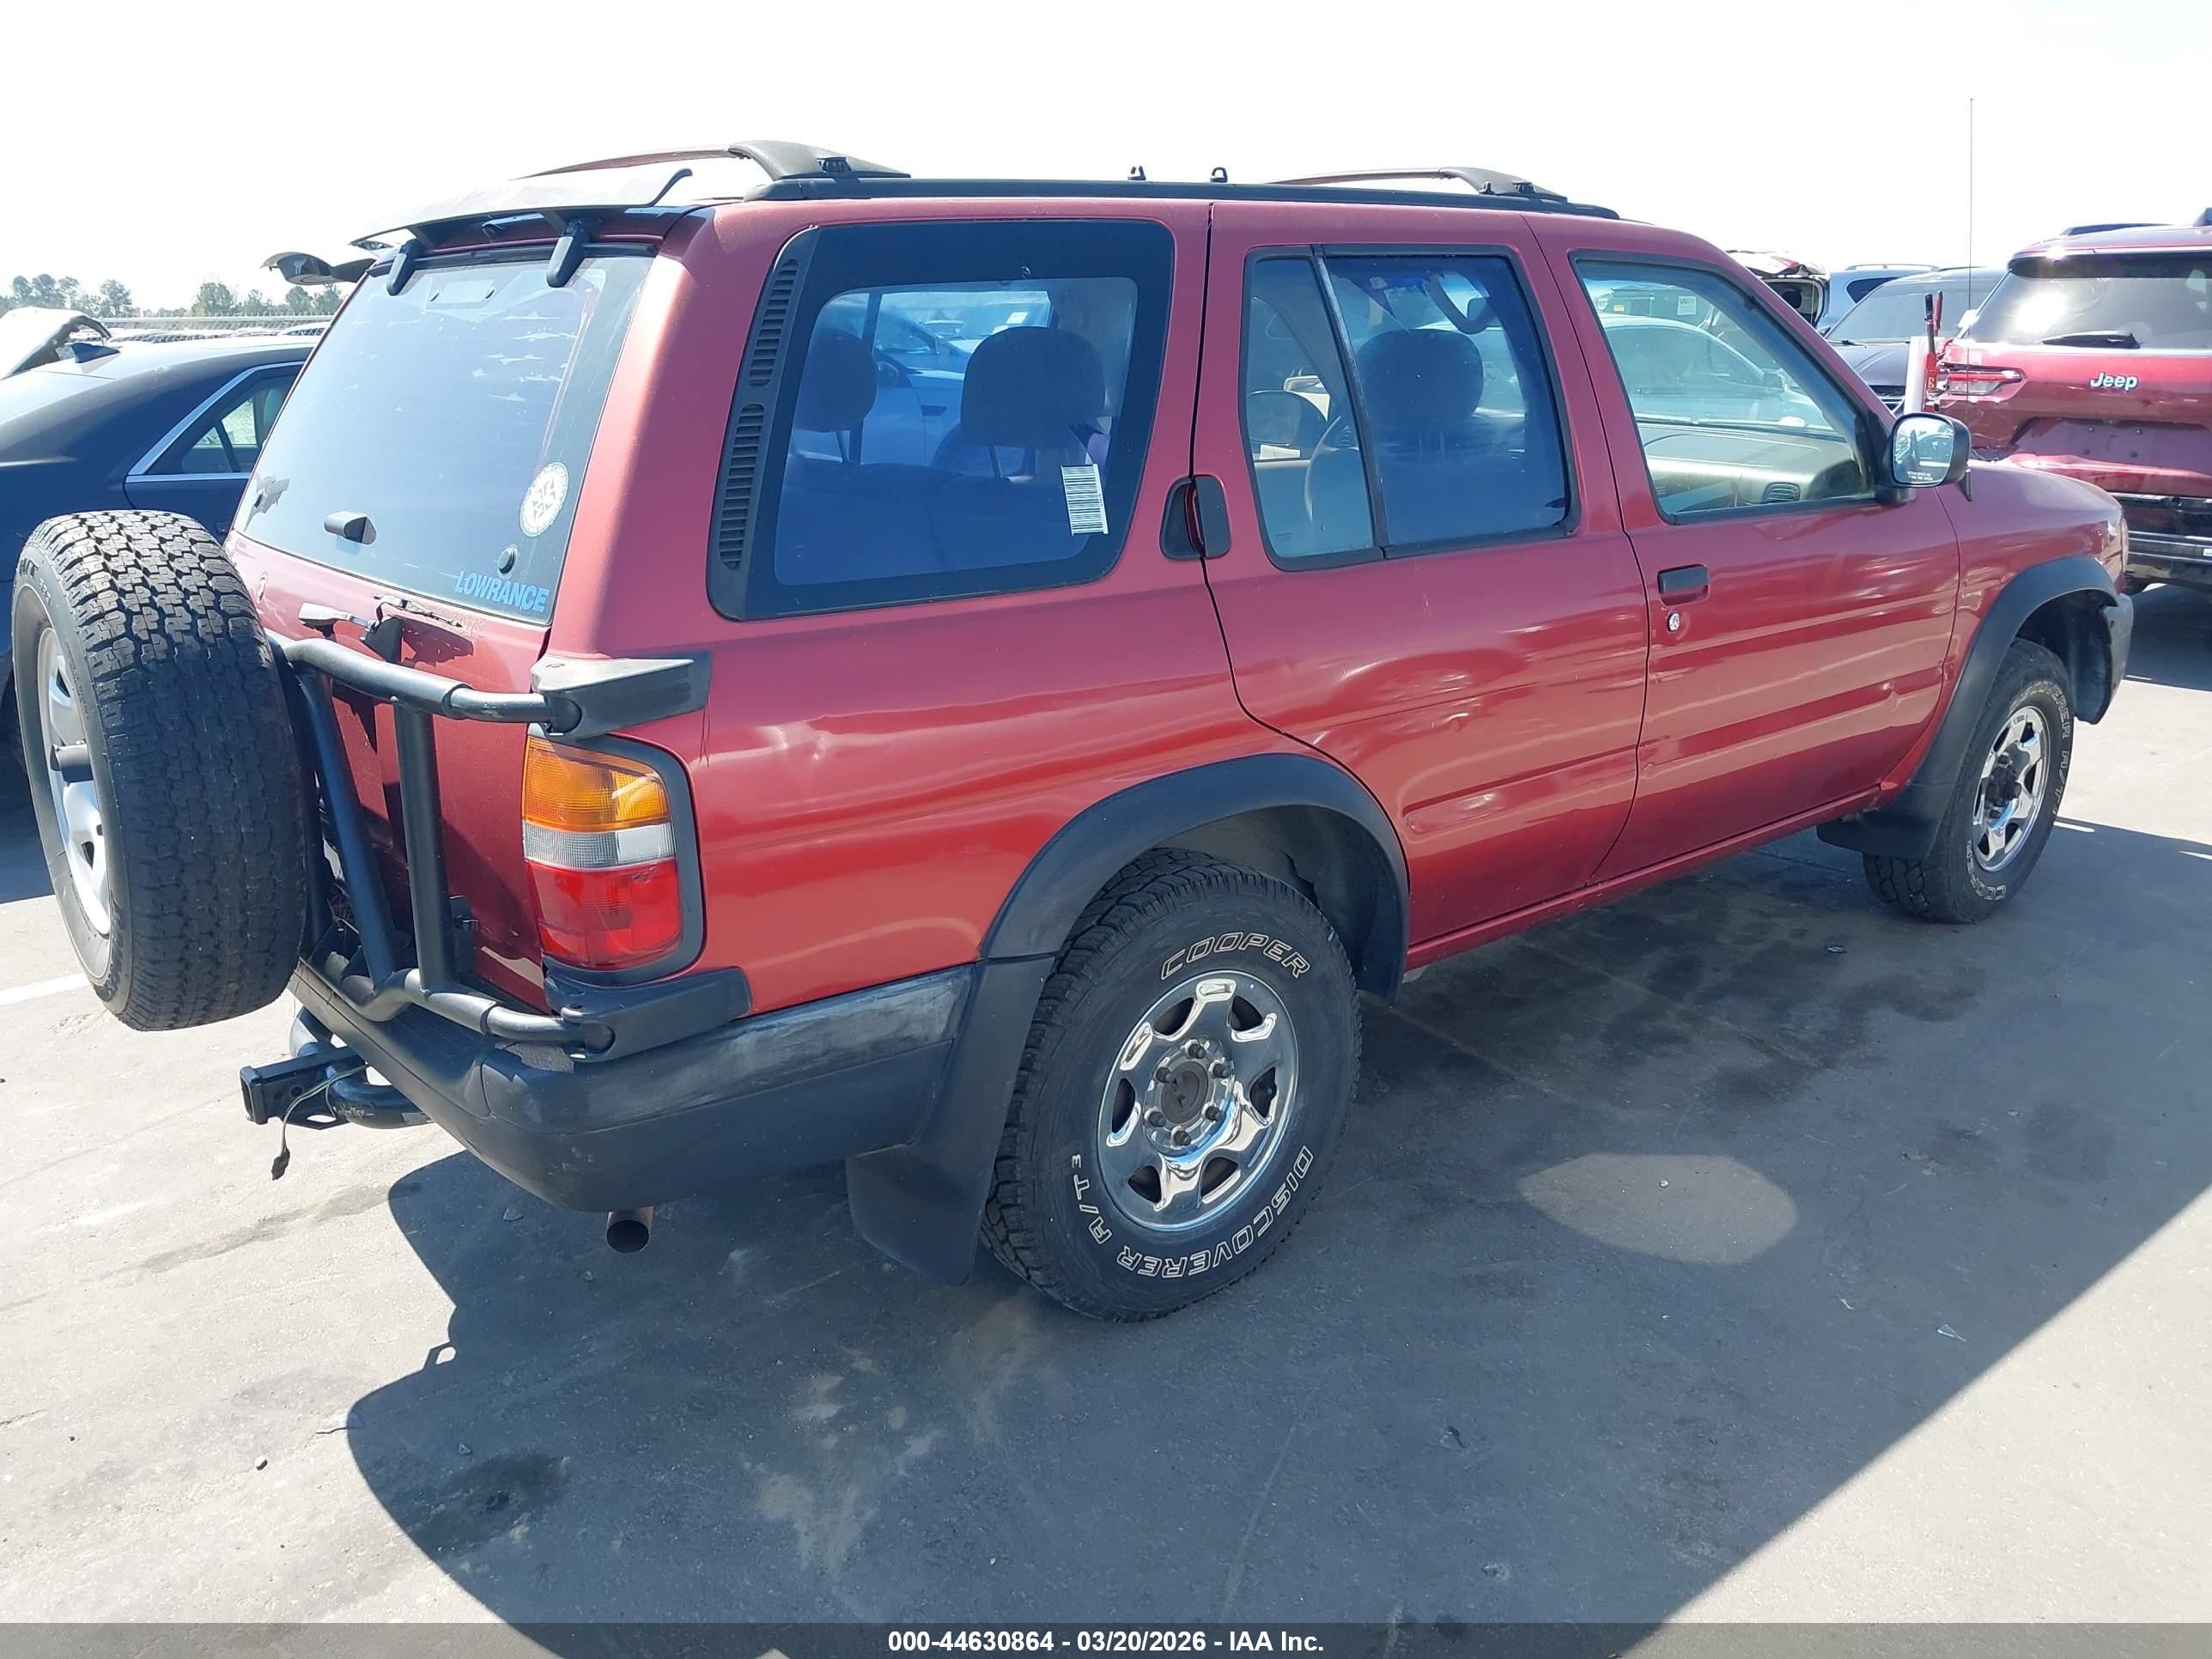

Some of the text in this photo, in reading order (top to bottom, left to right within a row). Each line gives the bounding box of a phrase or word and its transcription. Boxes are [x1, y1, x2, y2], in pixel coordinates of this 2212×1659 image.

[2089, 372, 2138, 391] Jeep
[454, 570, 550, 612] LOWRANCE
[1161, 932, 1311, 981] COOPER
[1116, 1145, 1314, 1278] DISCOVERER
